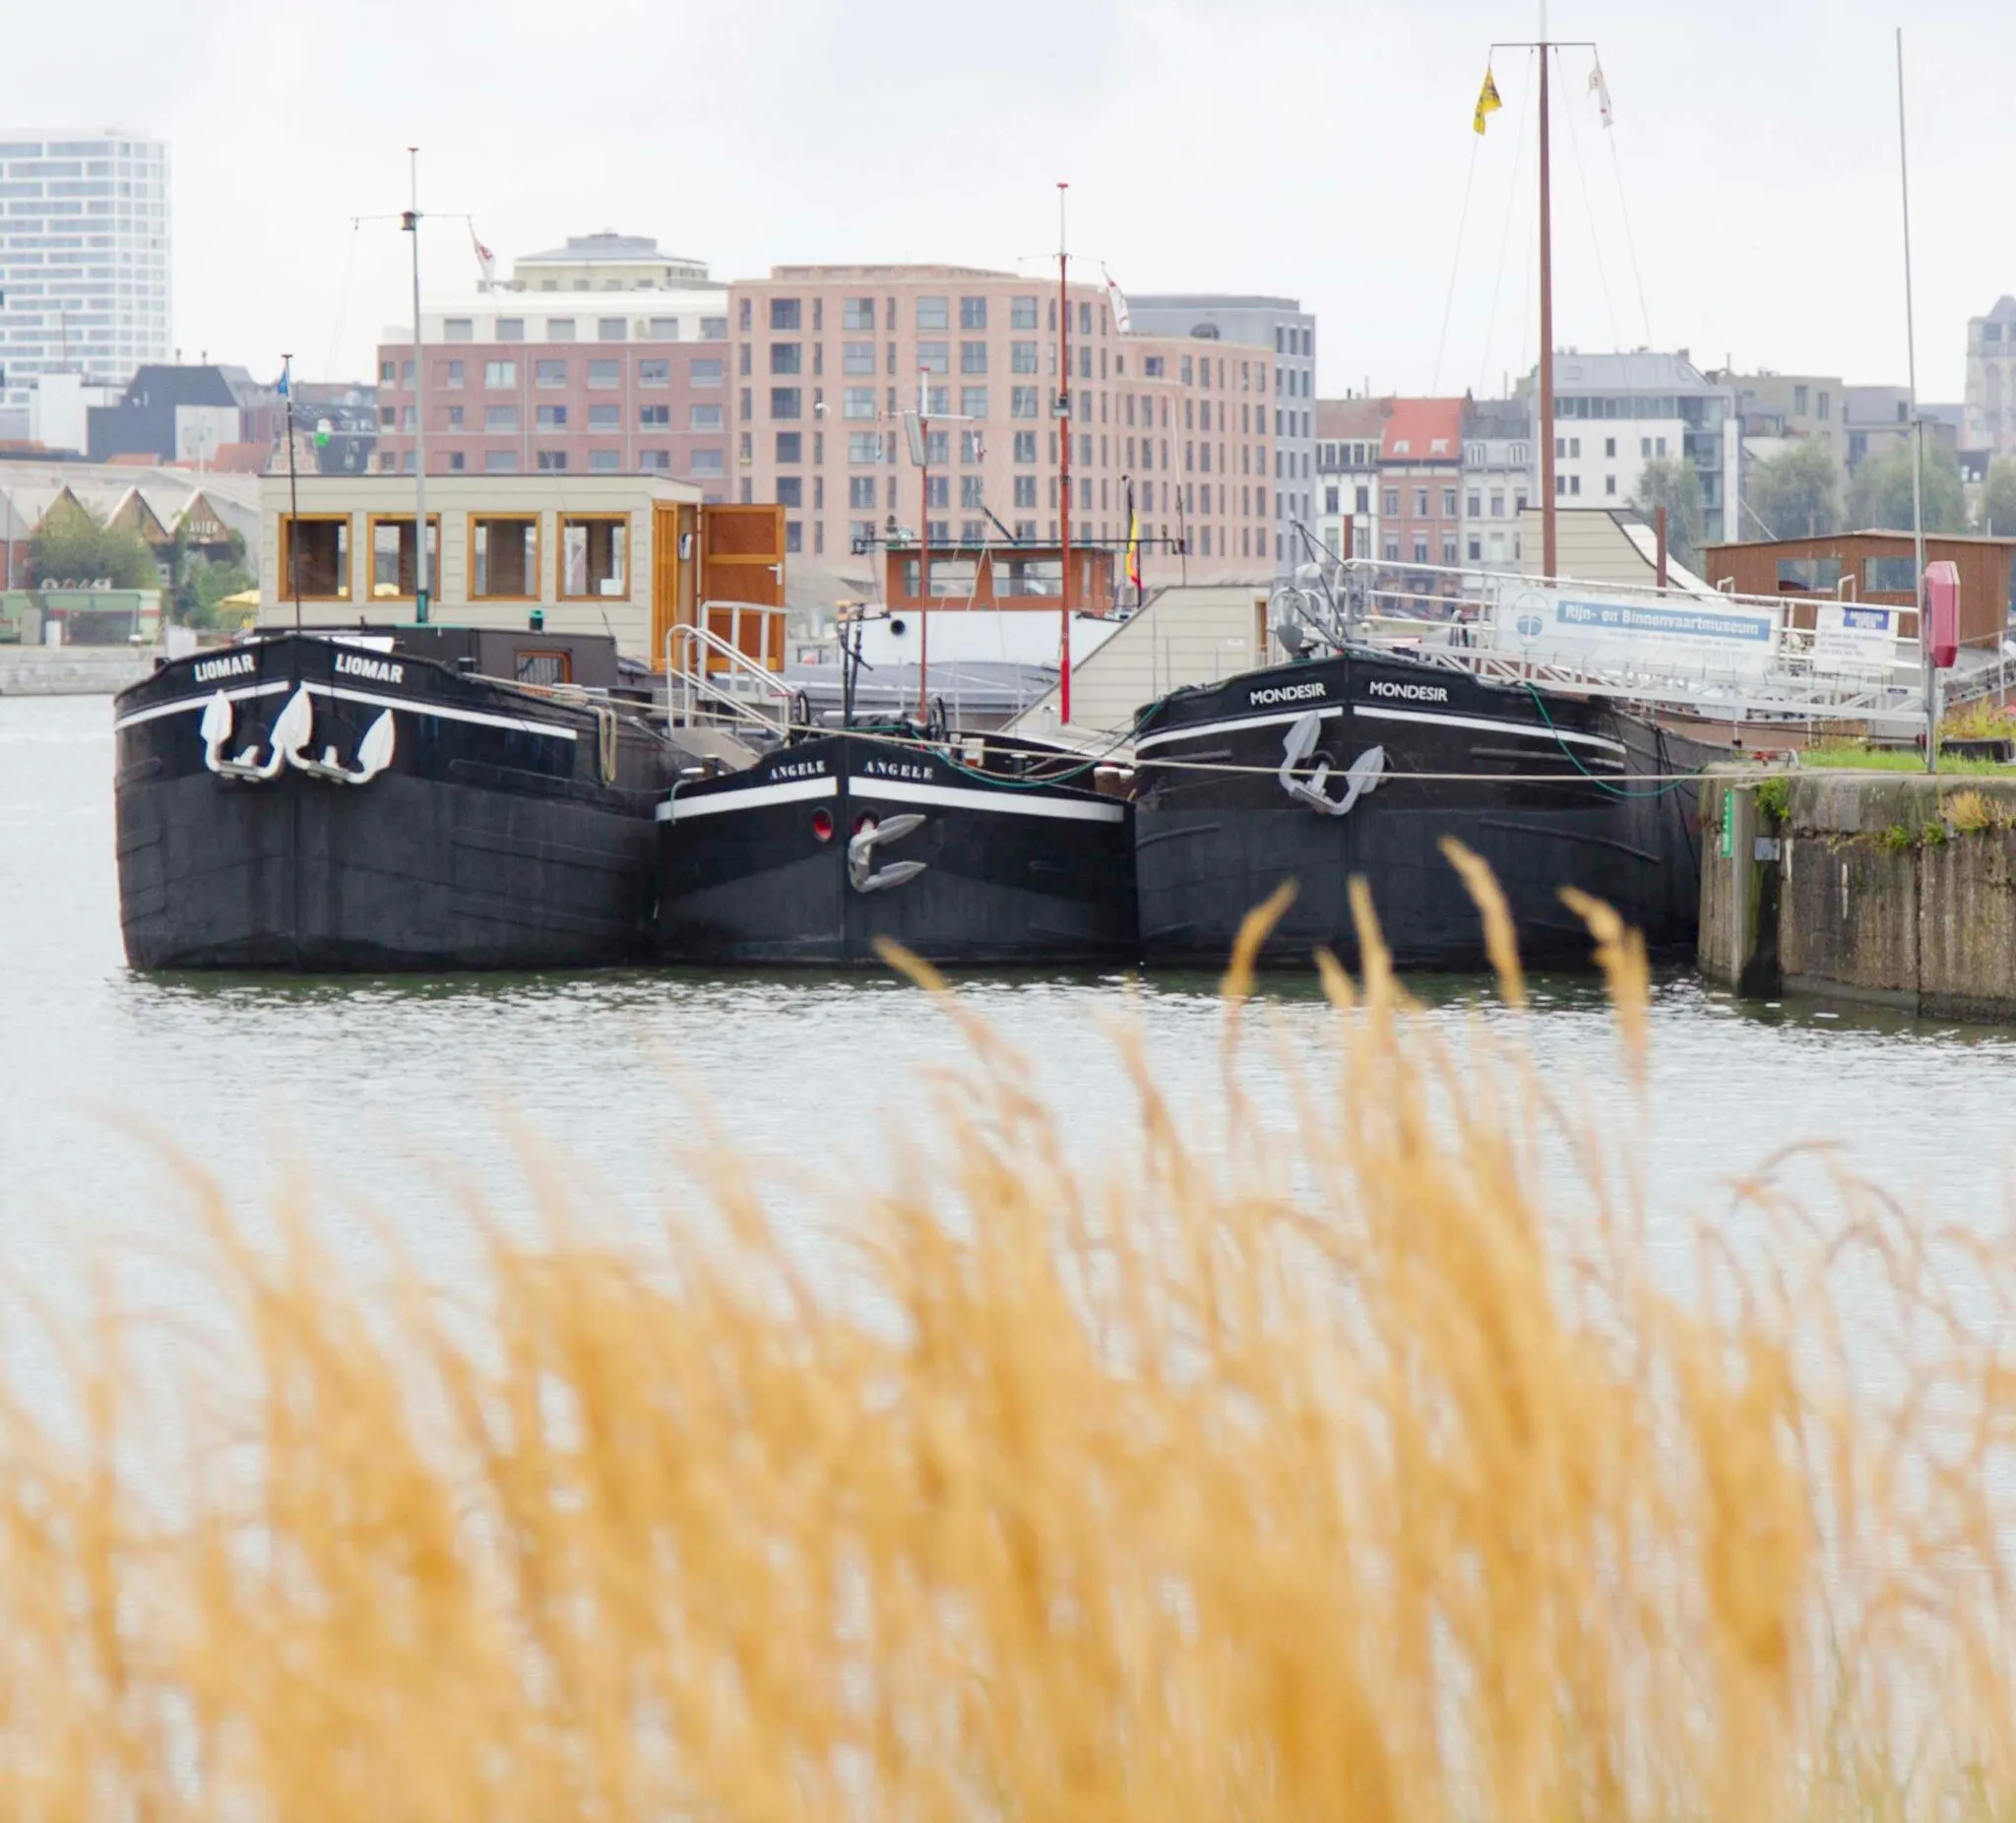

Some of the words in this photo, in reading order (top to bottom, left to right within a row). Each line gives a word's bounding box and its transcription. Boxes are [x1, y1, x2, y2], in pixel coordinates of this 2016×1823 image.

[1565, 604, 1597, 622] Rijn-
[1602, 611, 1618, 621] en
[1622, 608, 1759, 636] Binnenvaartmuseum
[194, 654, 256, 682] LIOMAR
[335, 654, 404, 683] LIOMAR
[1250, 682, 1326, 706] MONDESIR
[1369, 681, 1448, 702] MONDESIR
[770, 760, 826, 780] ANGELE
[863, 760, 933, 780] ANGELE
